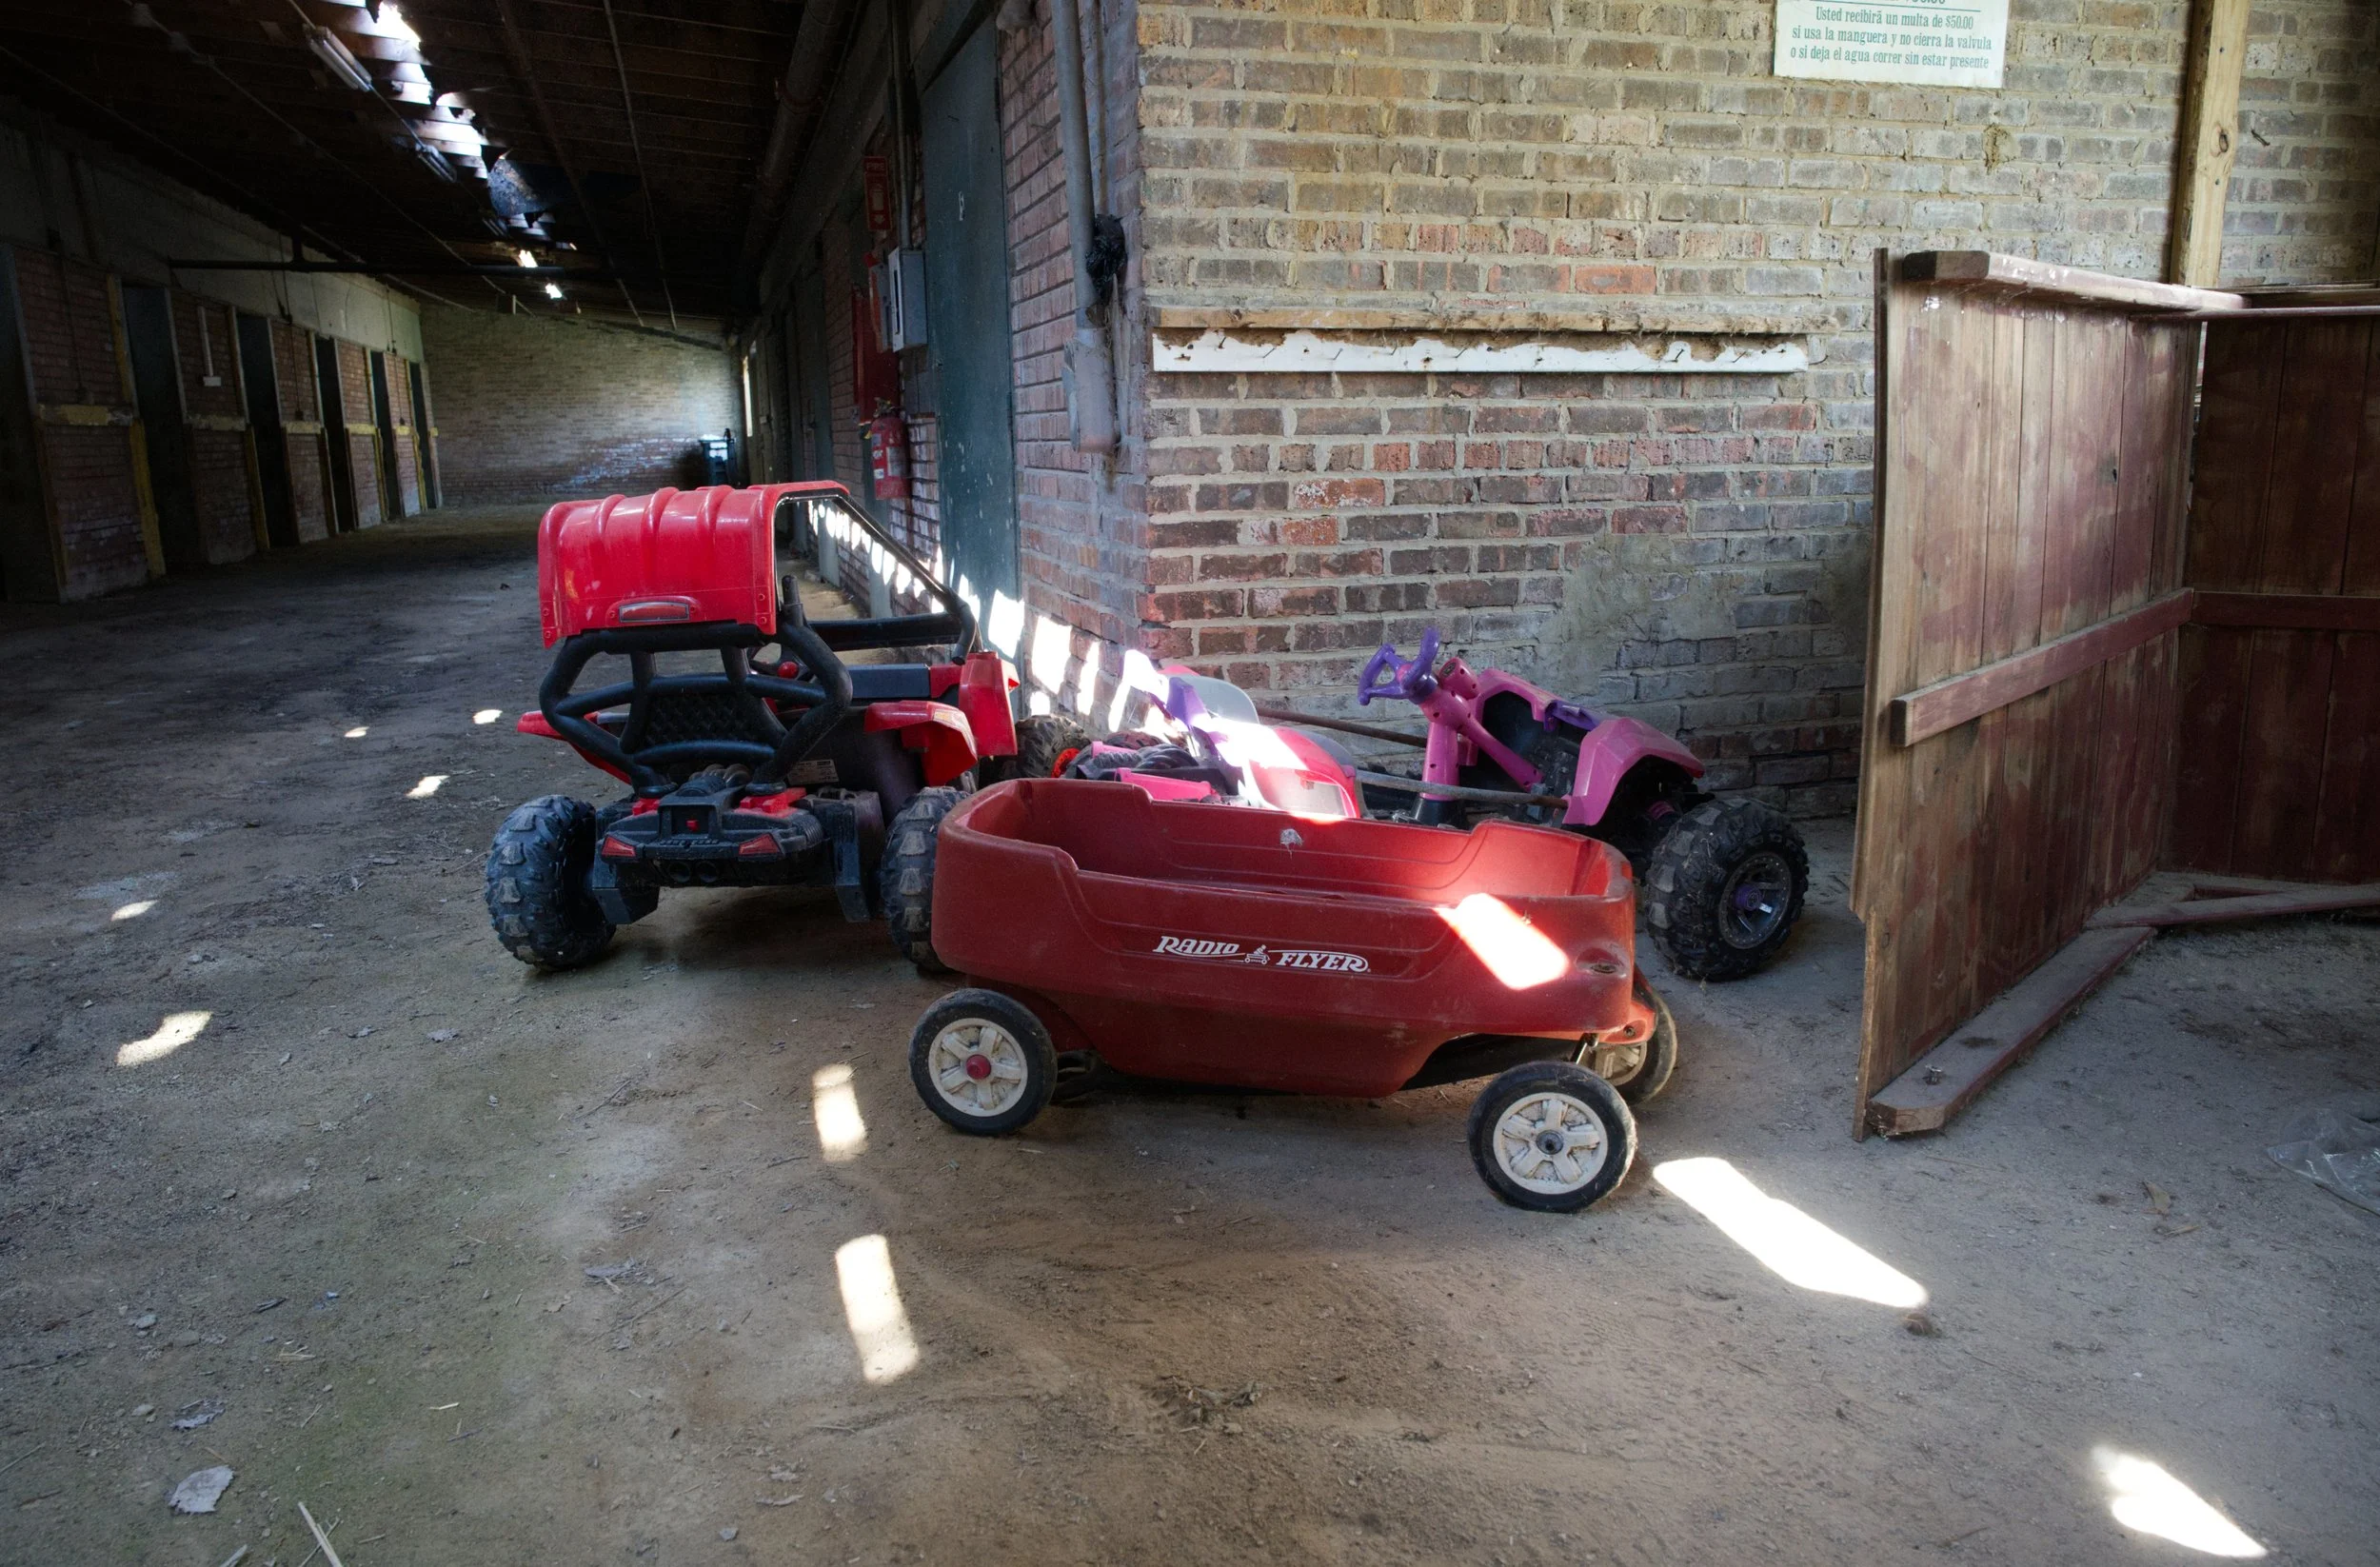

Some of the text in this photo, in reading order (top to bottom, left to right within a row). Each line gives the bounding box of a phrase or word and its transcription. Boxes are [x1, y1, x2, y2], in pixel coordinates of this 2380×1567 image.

[1815, 6, 1842, 22] Usted
[1886, 14, 1898, 25] un
[1901, 13, 1929, 27] multa
[1932, 14, 1943, 28] de
[1946, 15, 1973, 30] $50.00
[1792, 25, 1993, 50] si usa la manguera y no cierra la valvula
[1790, 45, 1990, 69] o si deja el agua correr sin estar presente
[1152, 935, 1369, 972] RADIO FLYER
